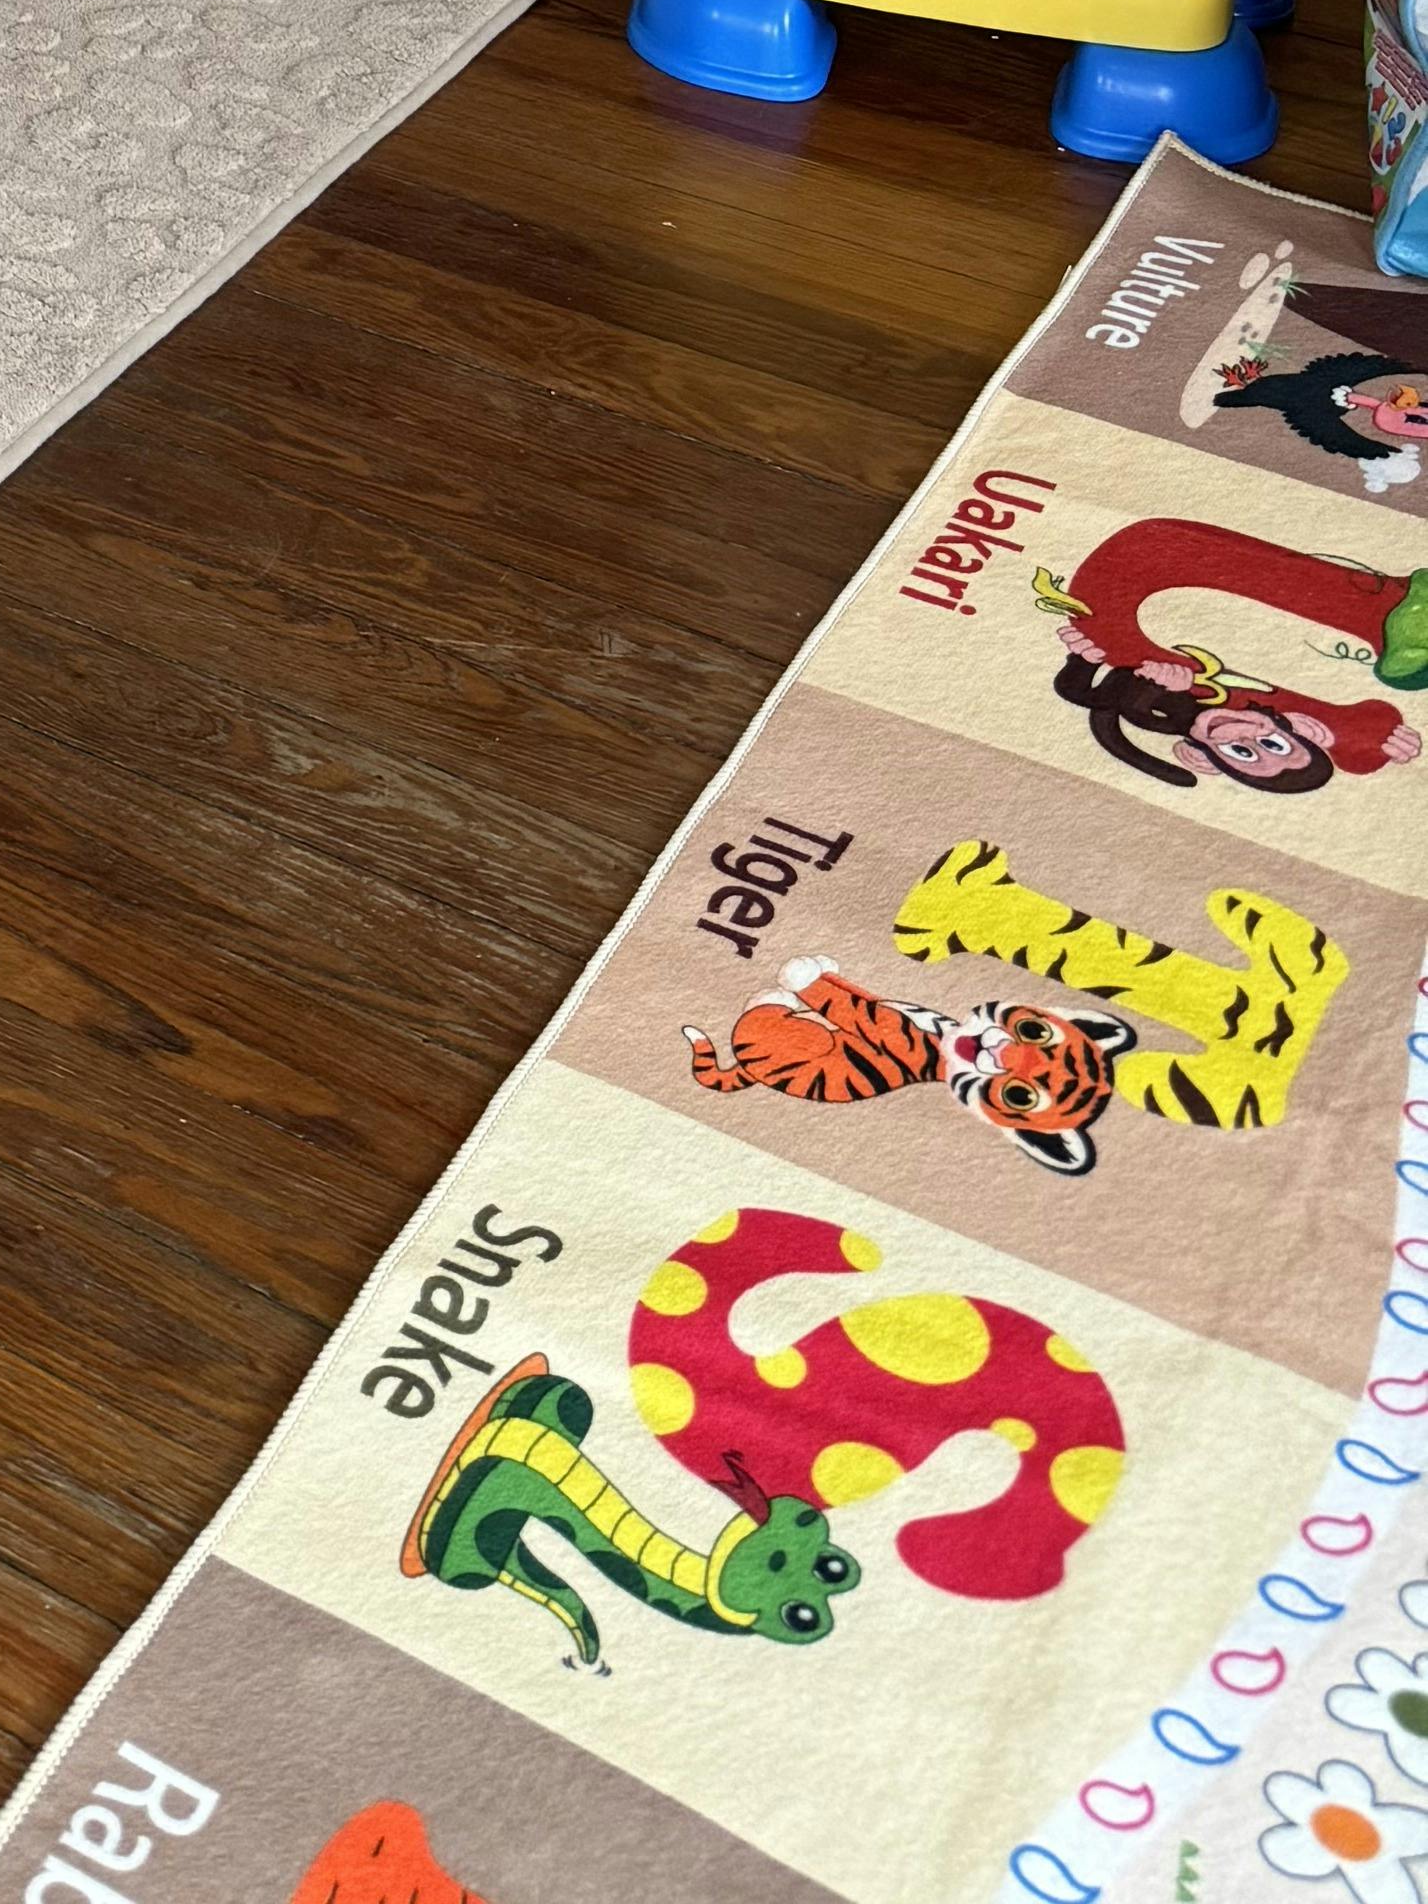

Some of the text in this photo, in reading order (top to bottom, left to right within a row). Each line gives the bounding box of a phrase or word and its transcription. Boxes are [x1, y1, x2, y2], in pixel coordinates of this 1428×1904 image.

[1087, 231, 1227, 353] Vulture
[898, 465, 1059, 616] Uakari
[698, 815, 856, 960] Tiger
[359, 1204, 565, 1422] Snake
